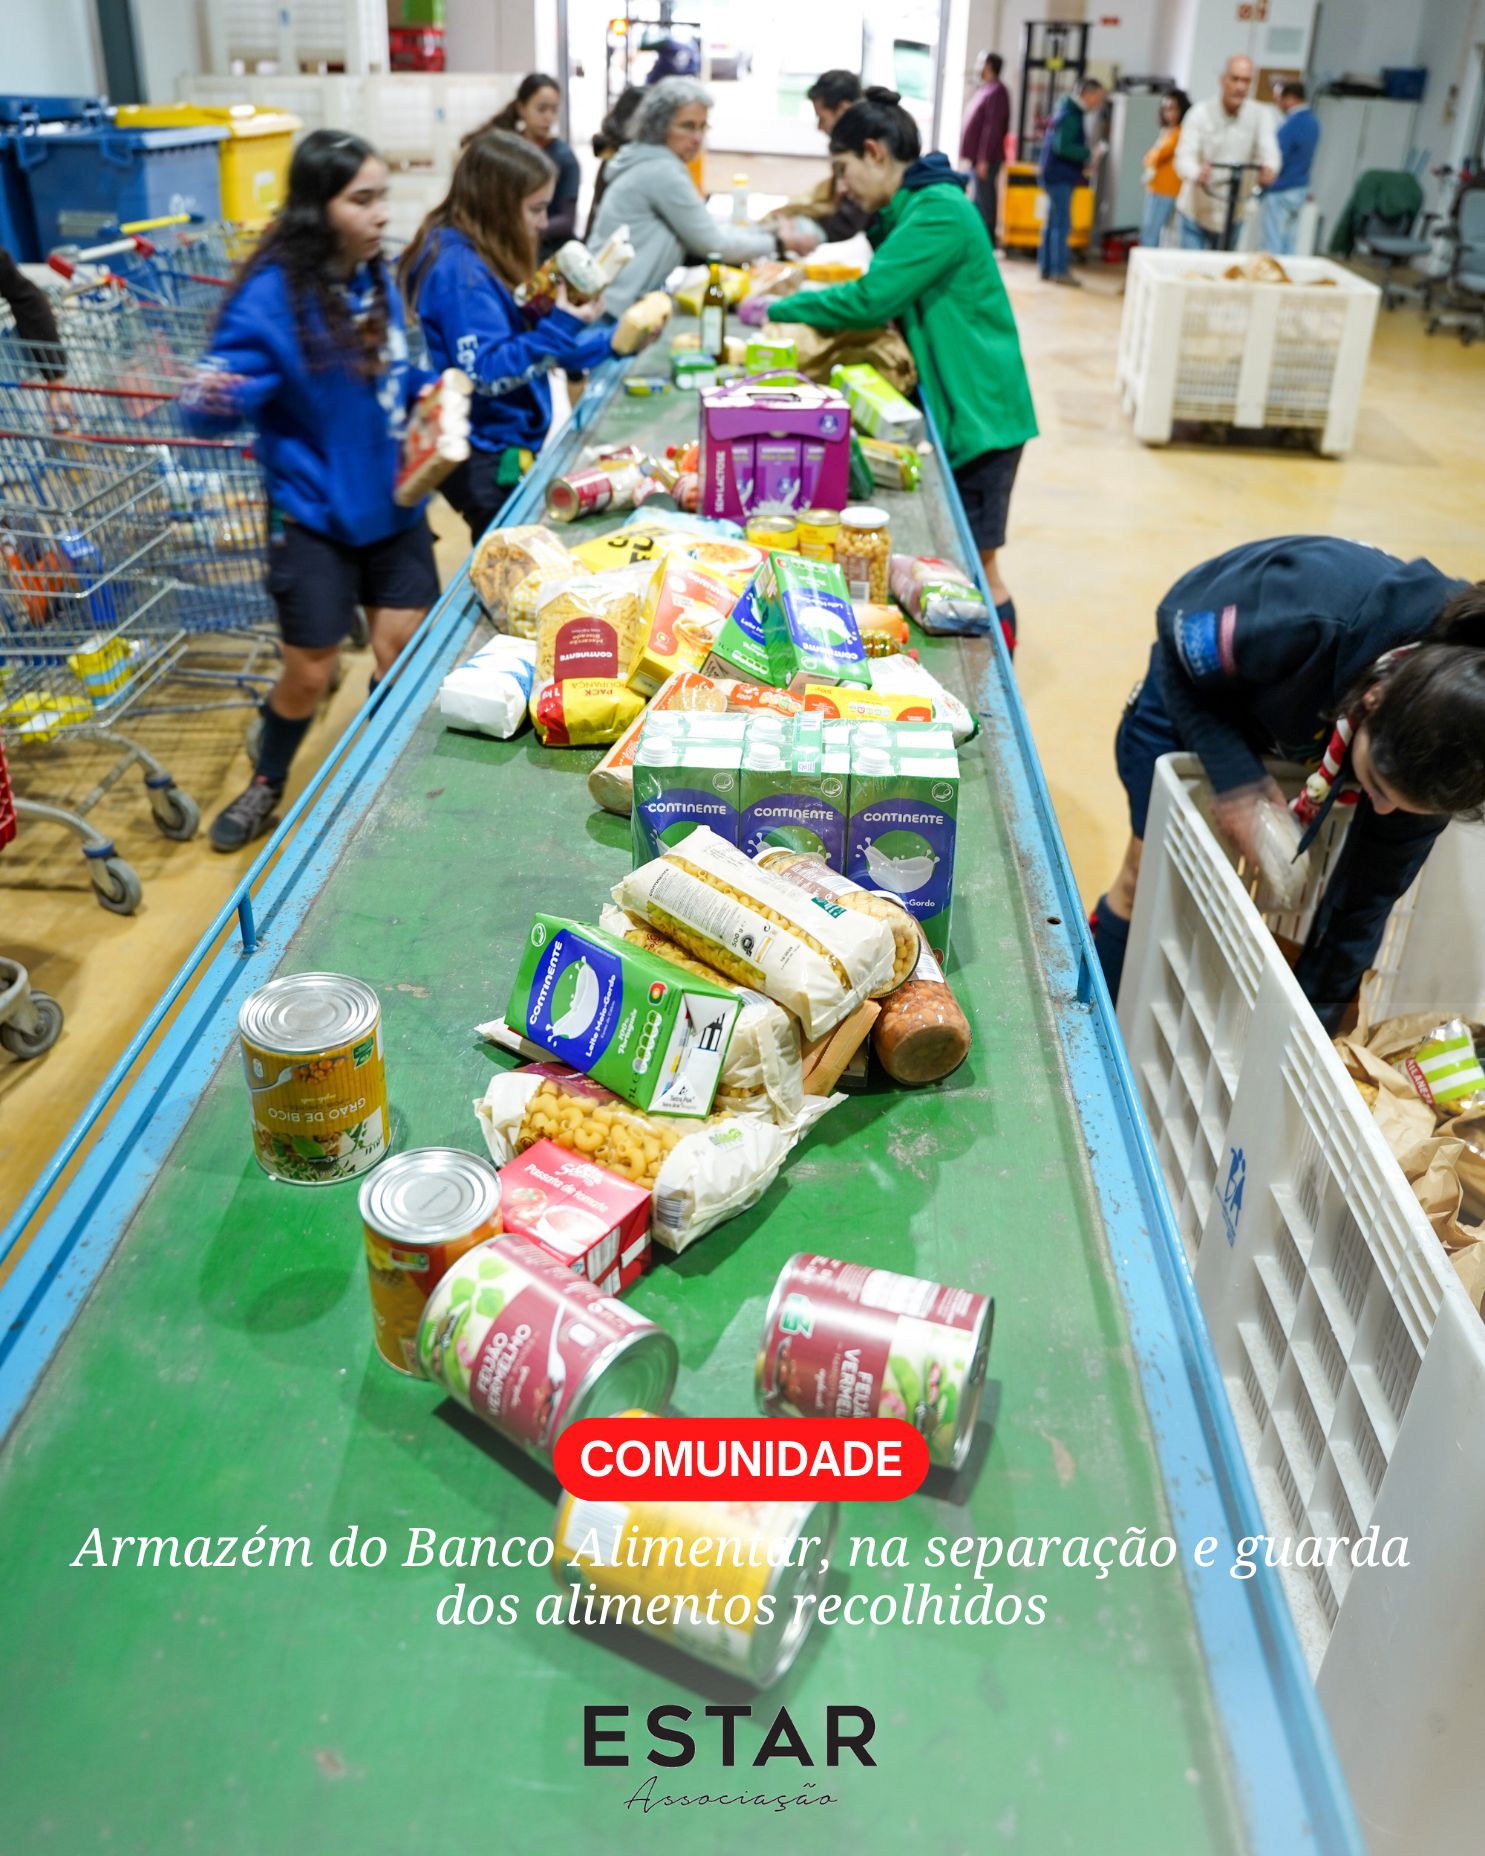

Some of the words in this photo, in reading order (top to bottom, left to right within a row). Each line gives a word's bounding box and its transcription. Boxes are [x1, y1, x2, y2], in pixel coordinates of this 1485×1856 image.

[715, 451, 726, 493] LACTOSE
[559, 651, 613, 662] CONTINENTE
[584, 688, 613, 697] PACK
[647, 802, 727, 815] CONTINENTE
[753, 806, 834, 821] CONTINENTE
[863, 812, 944, 825] CONTINENTE
[529, 940, 563, 1025] CONTINENTE
[585, 1029, 599, 1058] Leite
[595, 974, 617, 1030] Meio-Gordo
[267, 1107, 301, 1122] BICO
[328, 1097, 366, 1120] GRÃO
[305, 1111, 325, 1123] DE
[560, 1183, 577, 1195] de
[477, 1332, 509, 1394] FEIJÃO
[487, 1323, 532, 1416] VERMELHO
